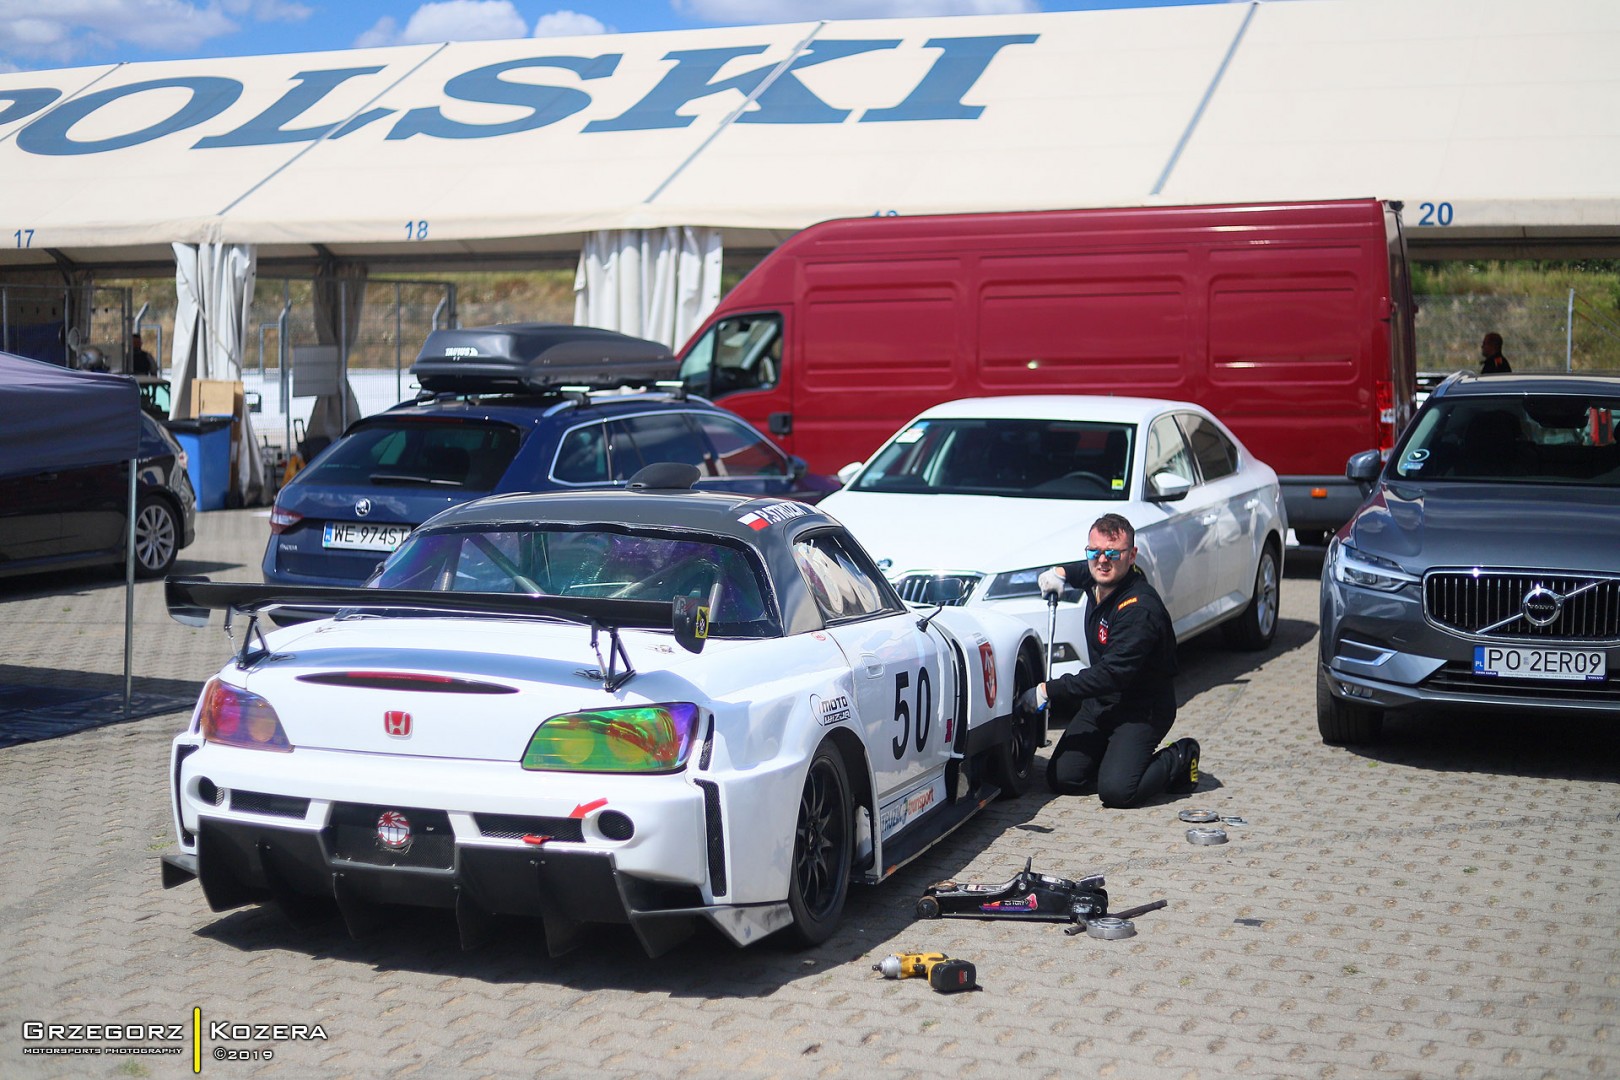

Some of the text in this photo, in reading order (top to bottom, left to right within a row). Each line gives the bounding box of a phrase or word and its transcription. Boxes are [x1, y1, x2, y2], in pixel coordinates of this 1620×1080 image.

[1418, 201, 1454, 226] 20
[13, 228, 35, 248] 17
[405, 220, 429, 241] 18
[334, 525, 408, 545] WE 974ST
[1488, 649, 1601, 674] PO 2ER09
[893, 666, 931, 760] 50
